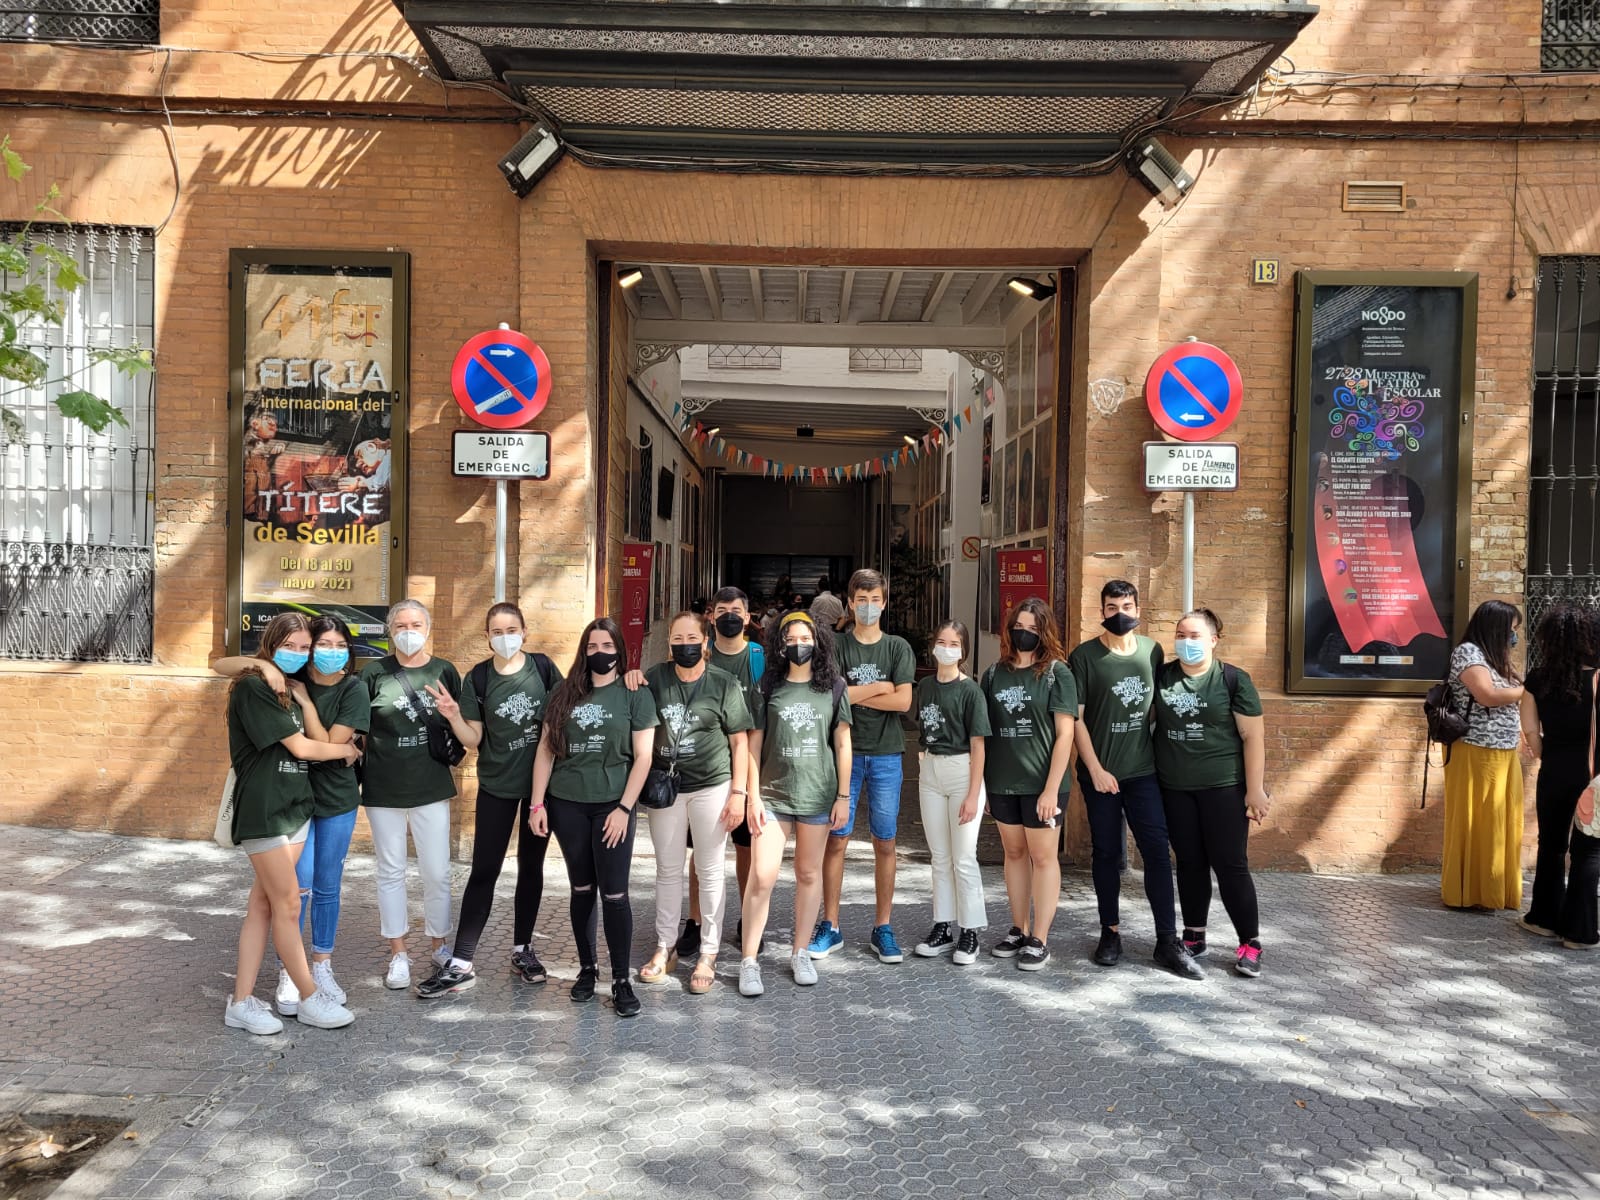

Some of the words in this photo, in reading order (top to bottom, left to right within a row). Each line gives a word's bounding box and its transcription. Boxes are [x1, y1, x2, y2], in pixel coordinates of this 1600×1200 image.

[1257, 263, 1275, 280] 13
[259, 358, 387, 391] FERIA
[1365, 368, 1417, 380] MUESTRA
[1367, 379, 1419, 395] TEATRO
[1383, 388, 1441, 402] ESCOLAR
[261, 395, 358, 411] internacional
[363, 398, 385, 412] del
[478, 436, 524, 446] SALIDA
[492, 450, 509, 459] DE
[1168, 449, 1213, 459] SALIDA
[1182, 462, 1198, 472] DE
[1148, 475, 1231, 485] EMERGENCIA
[258, 481, 383, 516] TÍTERE
[257, 522, 287, 543] de
[297, 523, 379, 545] Sevilla
[280, 556, 301, 570] Del
[320, 559, 333, 571] al
[335, 558, 352, 571] 30
[280, 577, 315, 590] mayo
[320, 577, 352, 590] 2021
